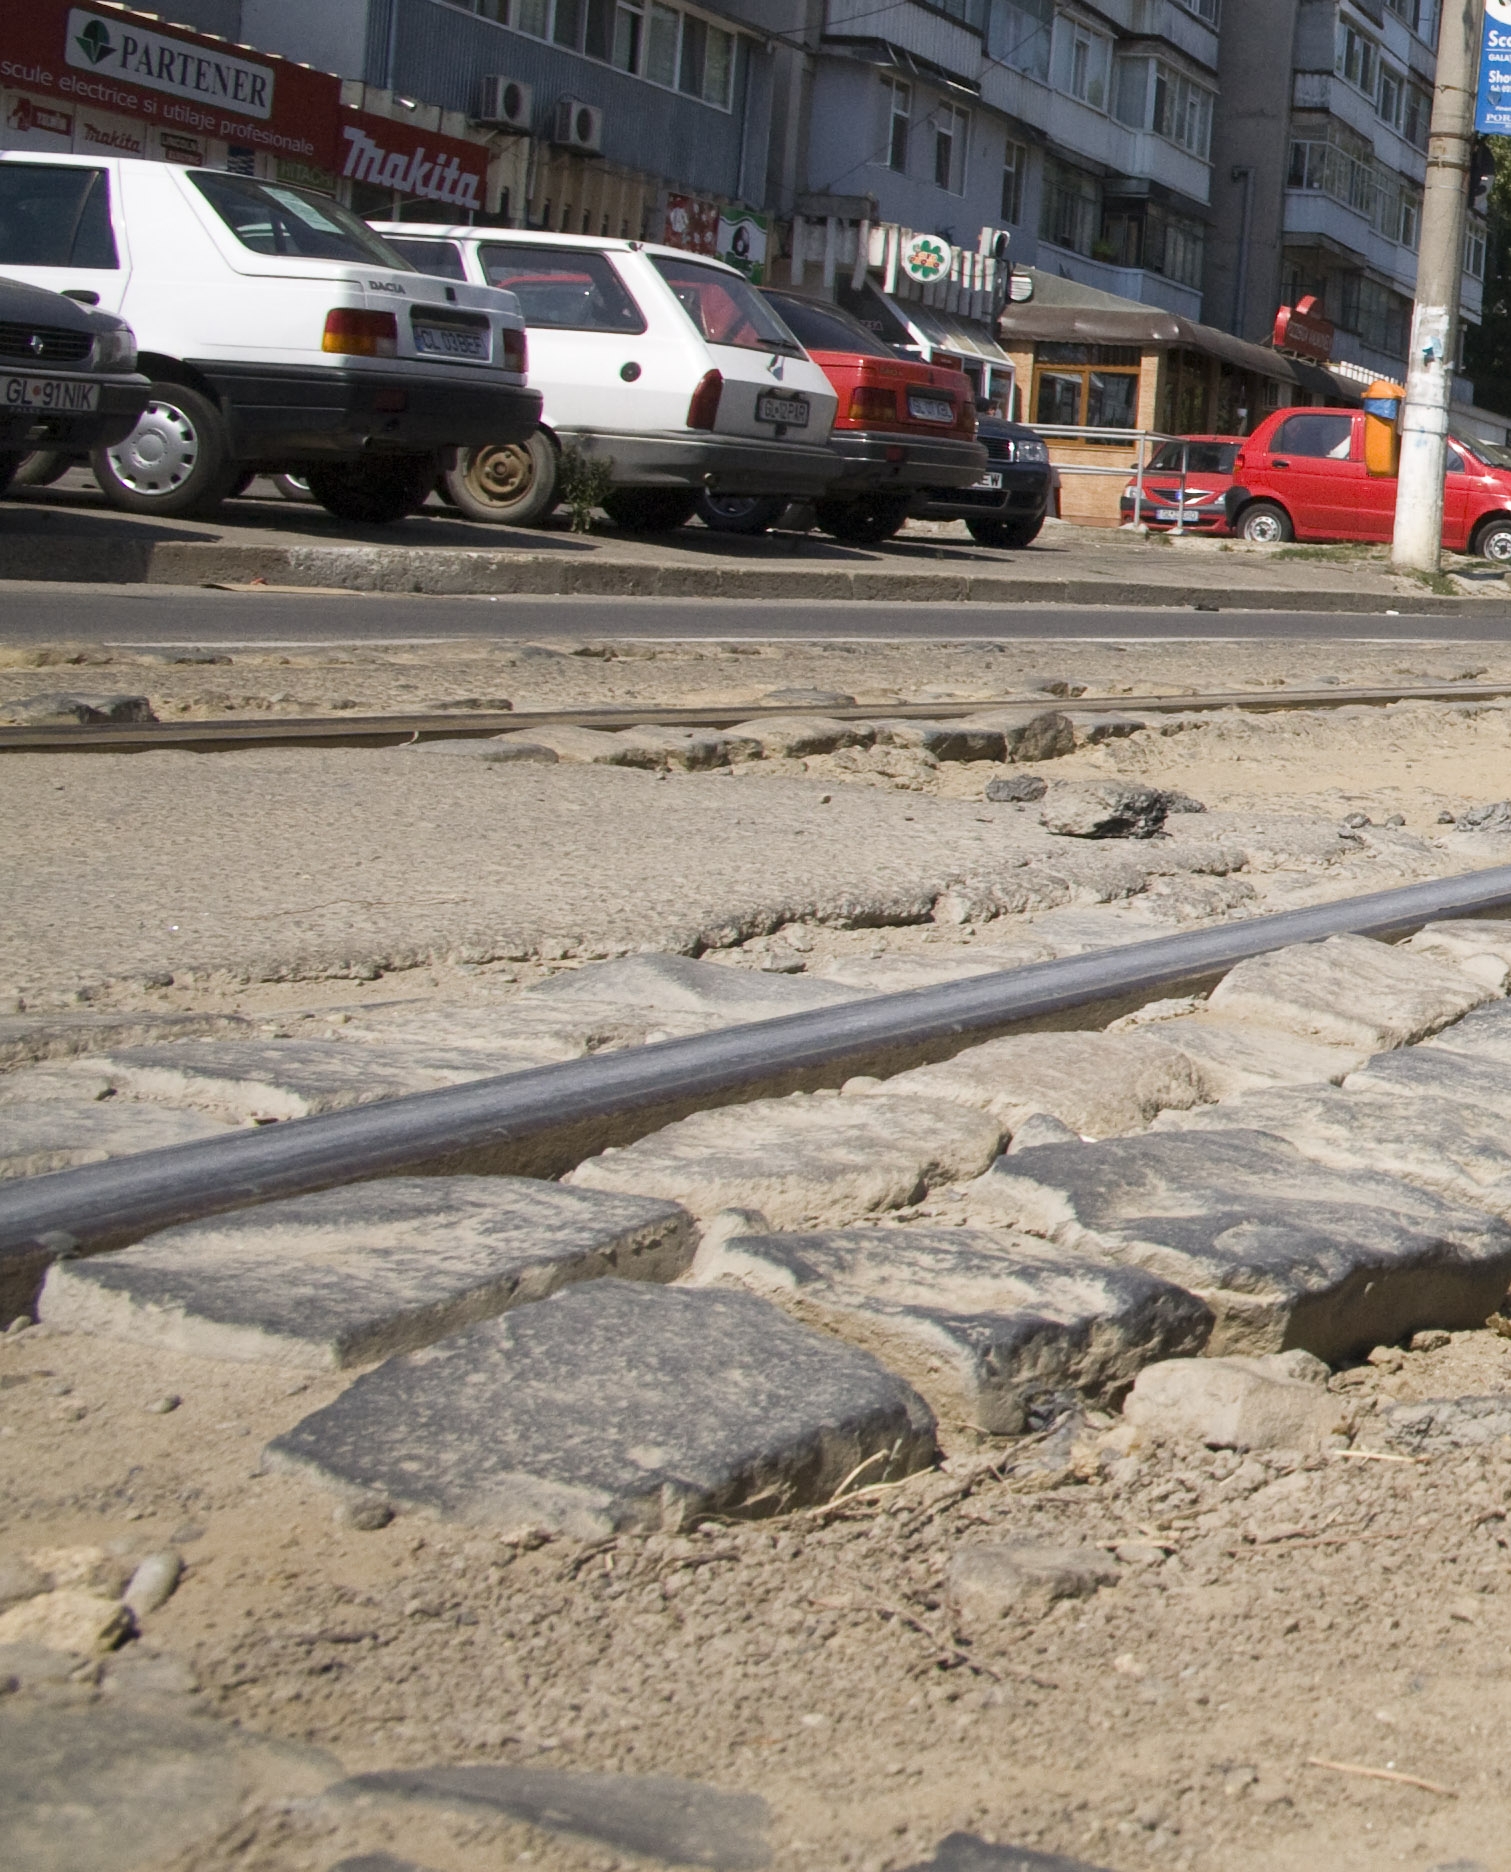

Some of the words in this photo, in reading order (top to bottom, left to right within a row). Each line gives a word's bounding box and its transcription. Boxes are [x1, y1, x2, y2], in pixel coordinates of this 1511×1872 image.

[1, 59, 54, 86] scule
[58, 74, 138, 109] electrice
[143, 98, 157, 115] si
[163, 101, 216, 132] utilaje
[219, 119, 315, 157] profesionale
[119, 33, 267, 108] PARTENER
[368, 280, 406, 294] DACIA
